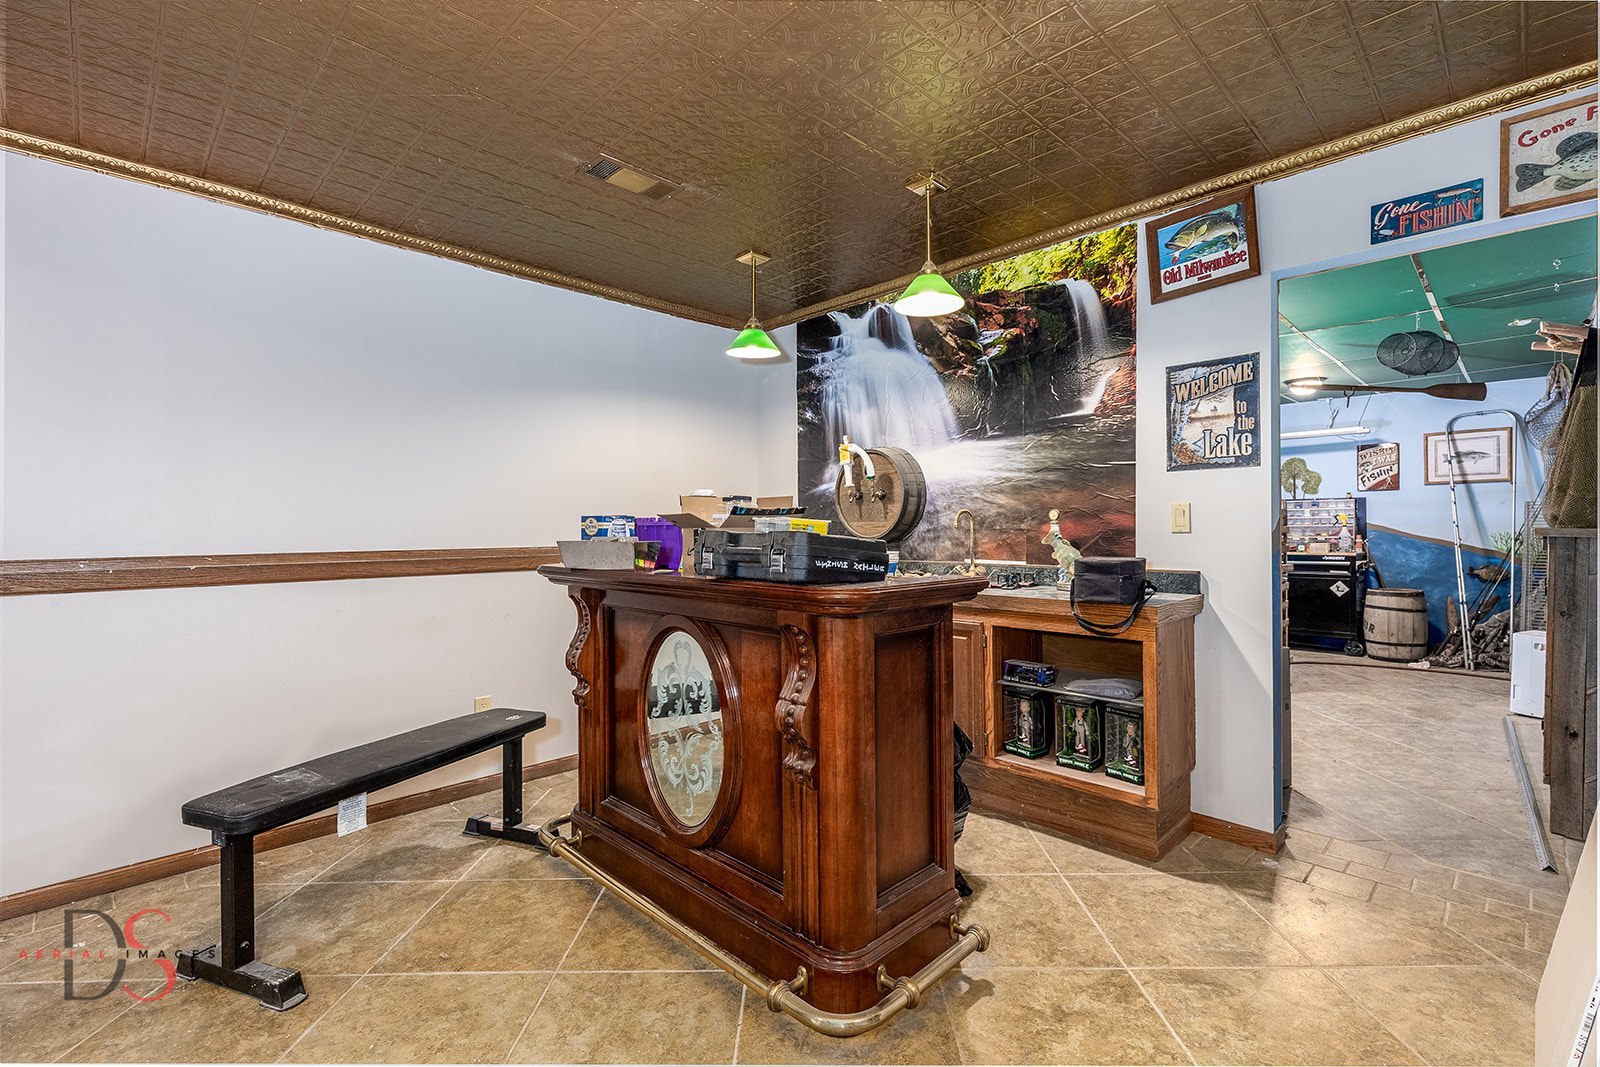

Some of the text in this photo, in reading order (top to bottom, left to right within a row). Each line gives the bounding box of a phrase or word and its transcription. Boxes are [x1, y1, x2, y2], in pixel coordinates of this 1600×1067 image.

[1518, 118, 1577, 147] Gone
[1374, 201, 1431, 230] Gone
[1163, 250, 1247, 285] Old Milwaukee
[1175, 361, 1254, 402] WELCOME
[1236, 400, 1247, 414] to
[1238, 415, 1255, 430] the
[1203, 427, 1253, 459] Lake
